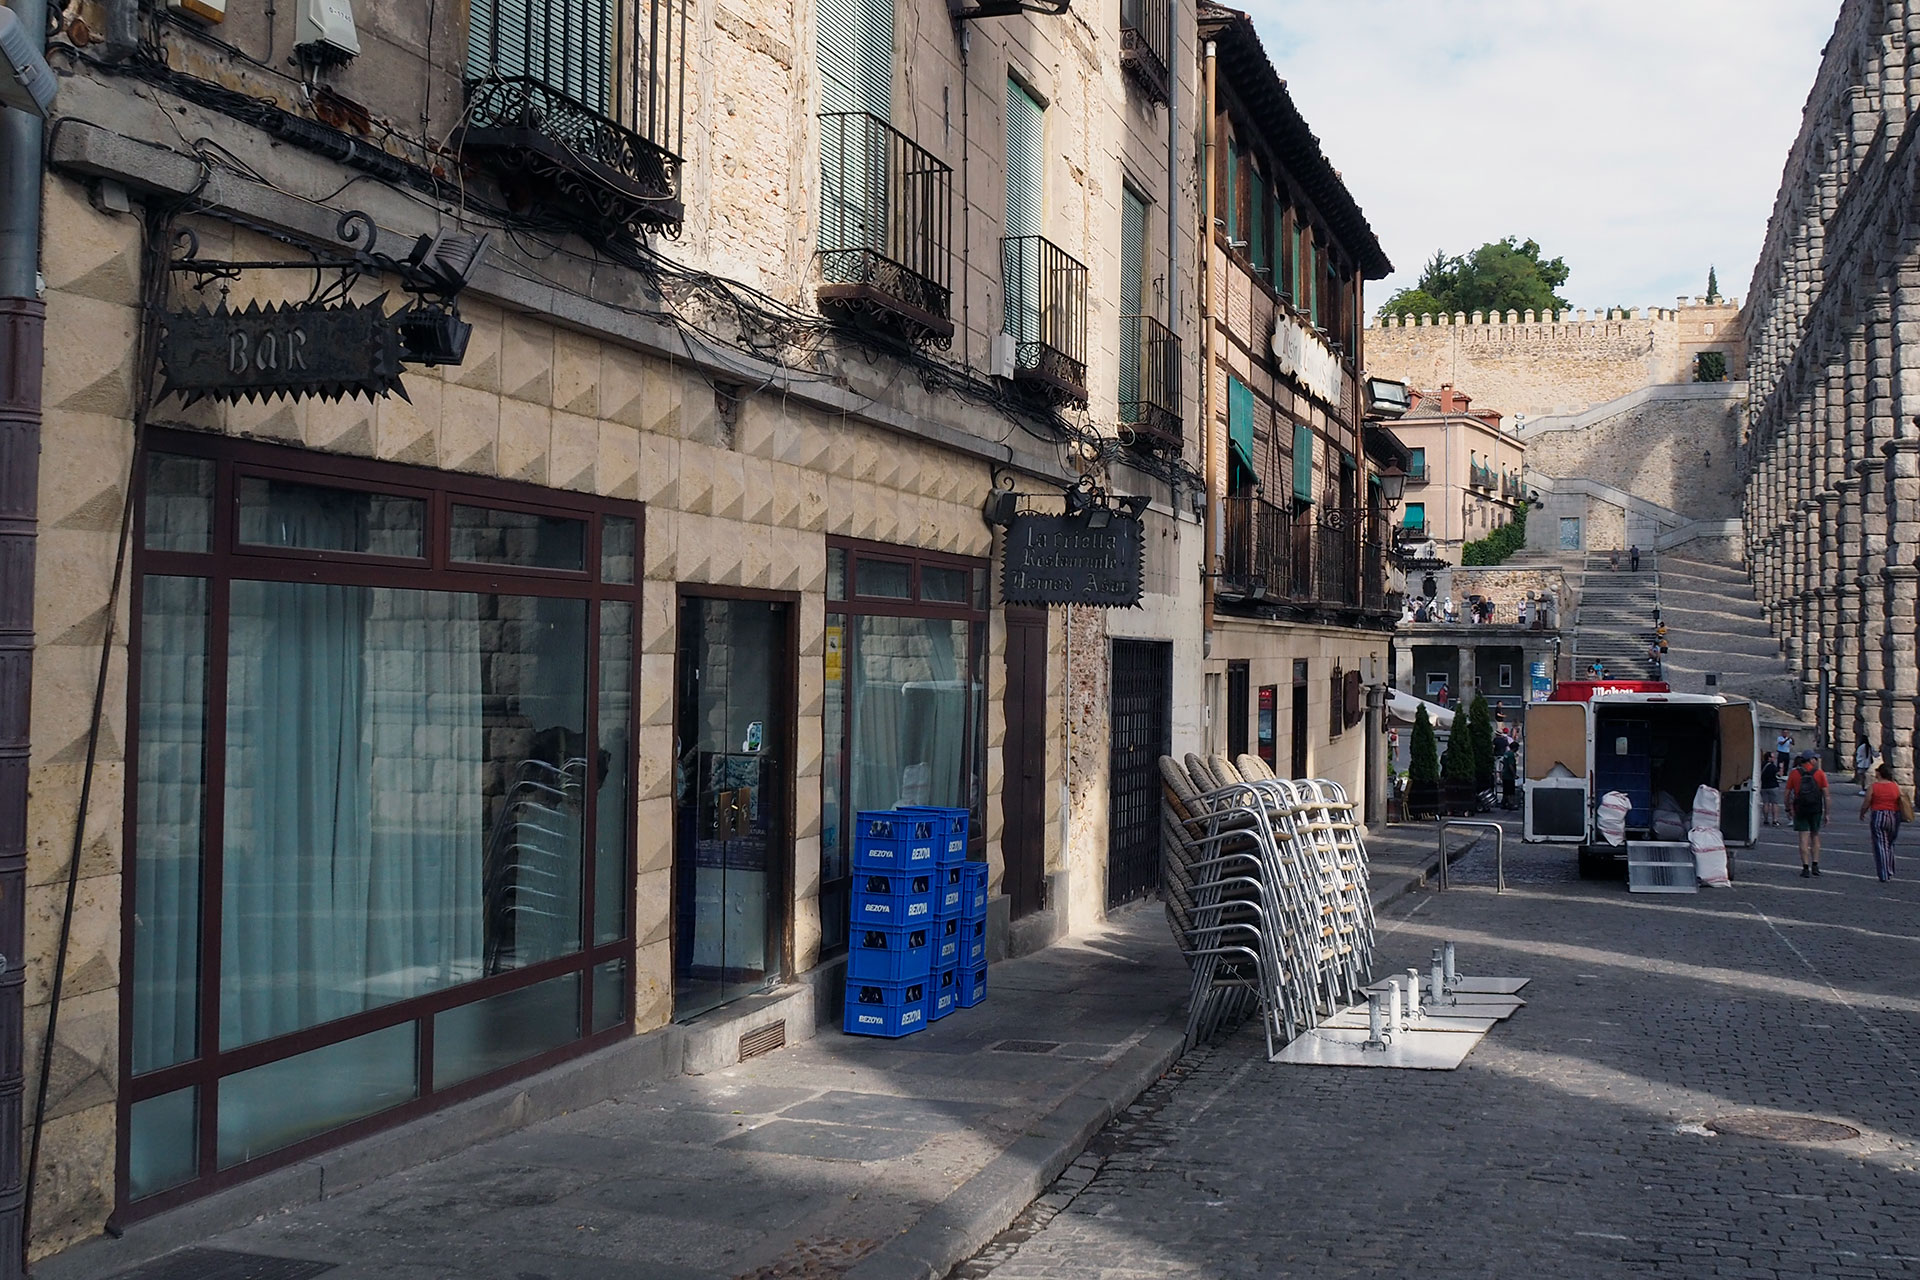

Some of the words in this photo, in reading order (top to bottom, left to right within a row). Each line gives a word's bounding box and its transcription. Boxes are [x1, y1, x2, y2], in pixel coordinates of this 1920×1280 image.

[230, 329, 307, 375] BAR
[1053, 530, 1117, 549] Criolla
[1023, 548, 1117, 568] Restaurante
[1082, 573, 1128, 592] Asar
[869, 849, 894, 858] BEZOYA
[912, 847, 931, 860] BEZOYA
[865, 903, 890, 913] BEZOYA
[909, 902, 928, 917] BEZOYA
[859, 1014, 884, 1025] BEZOYA
[902, 1009, 921, 1026] BEZOYA
